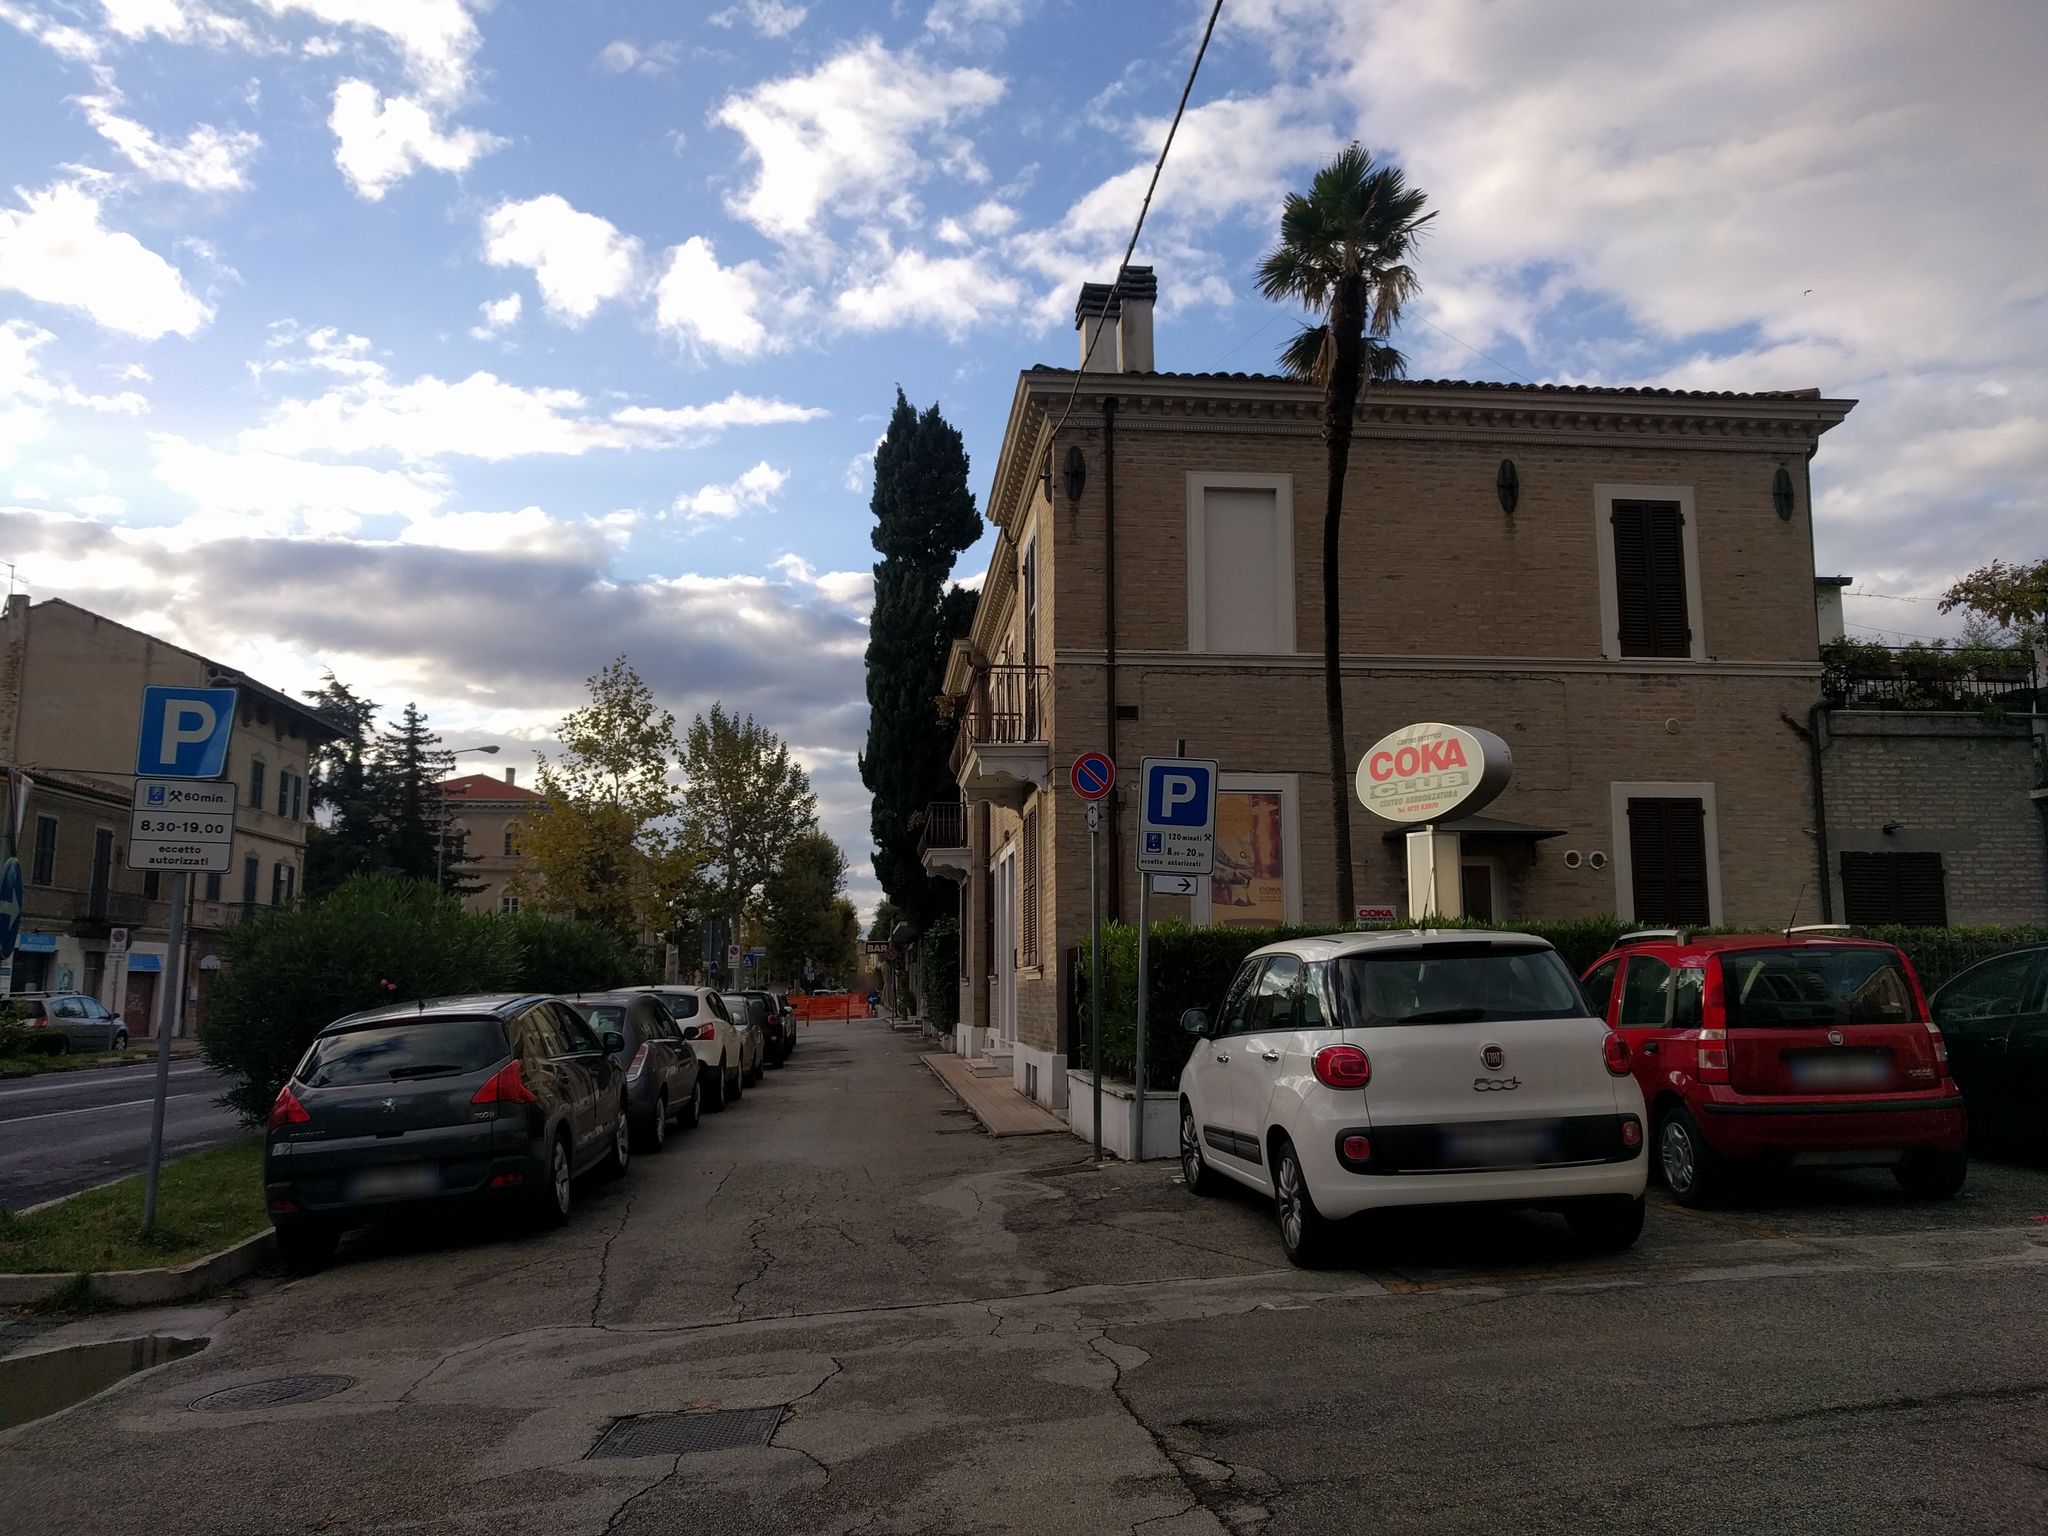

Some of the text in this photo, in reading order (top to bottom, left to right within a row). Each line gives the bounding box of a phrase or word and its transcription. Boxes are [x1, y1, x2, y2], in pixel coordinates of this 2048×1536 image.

[160, 699, 216, 764] P
[1369, 738, 1468, 782] COKA
[1374, 772, 1464, 797] CLUB
[1161, 774, 1196, 817] P
[1380, 798, 1403, 808] CENTRO
[1168, 833, 1182, 841] 120
[158, 845, 201, 854] eccetto
[148, 856, 209, 867] autorizzati
[1359, 909, 1392, 917] COKA
[867, 944, 888, 953] BAR
[1487, 1052, 1501, 1064] FIAT
